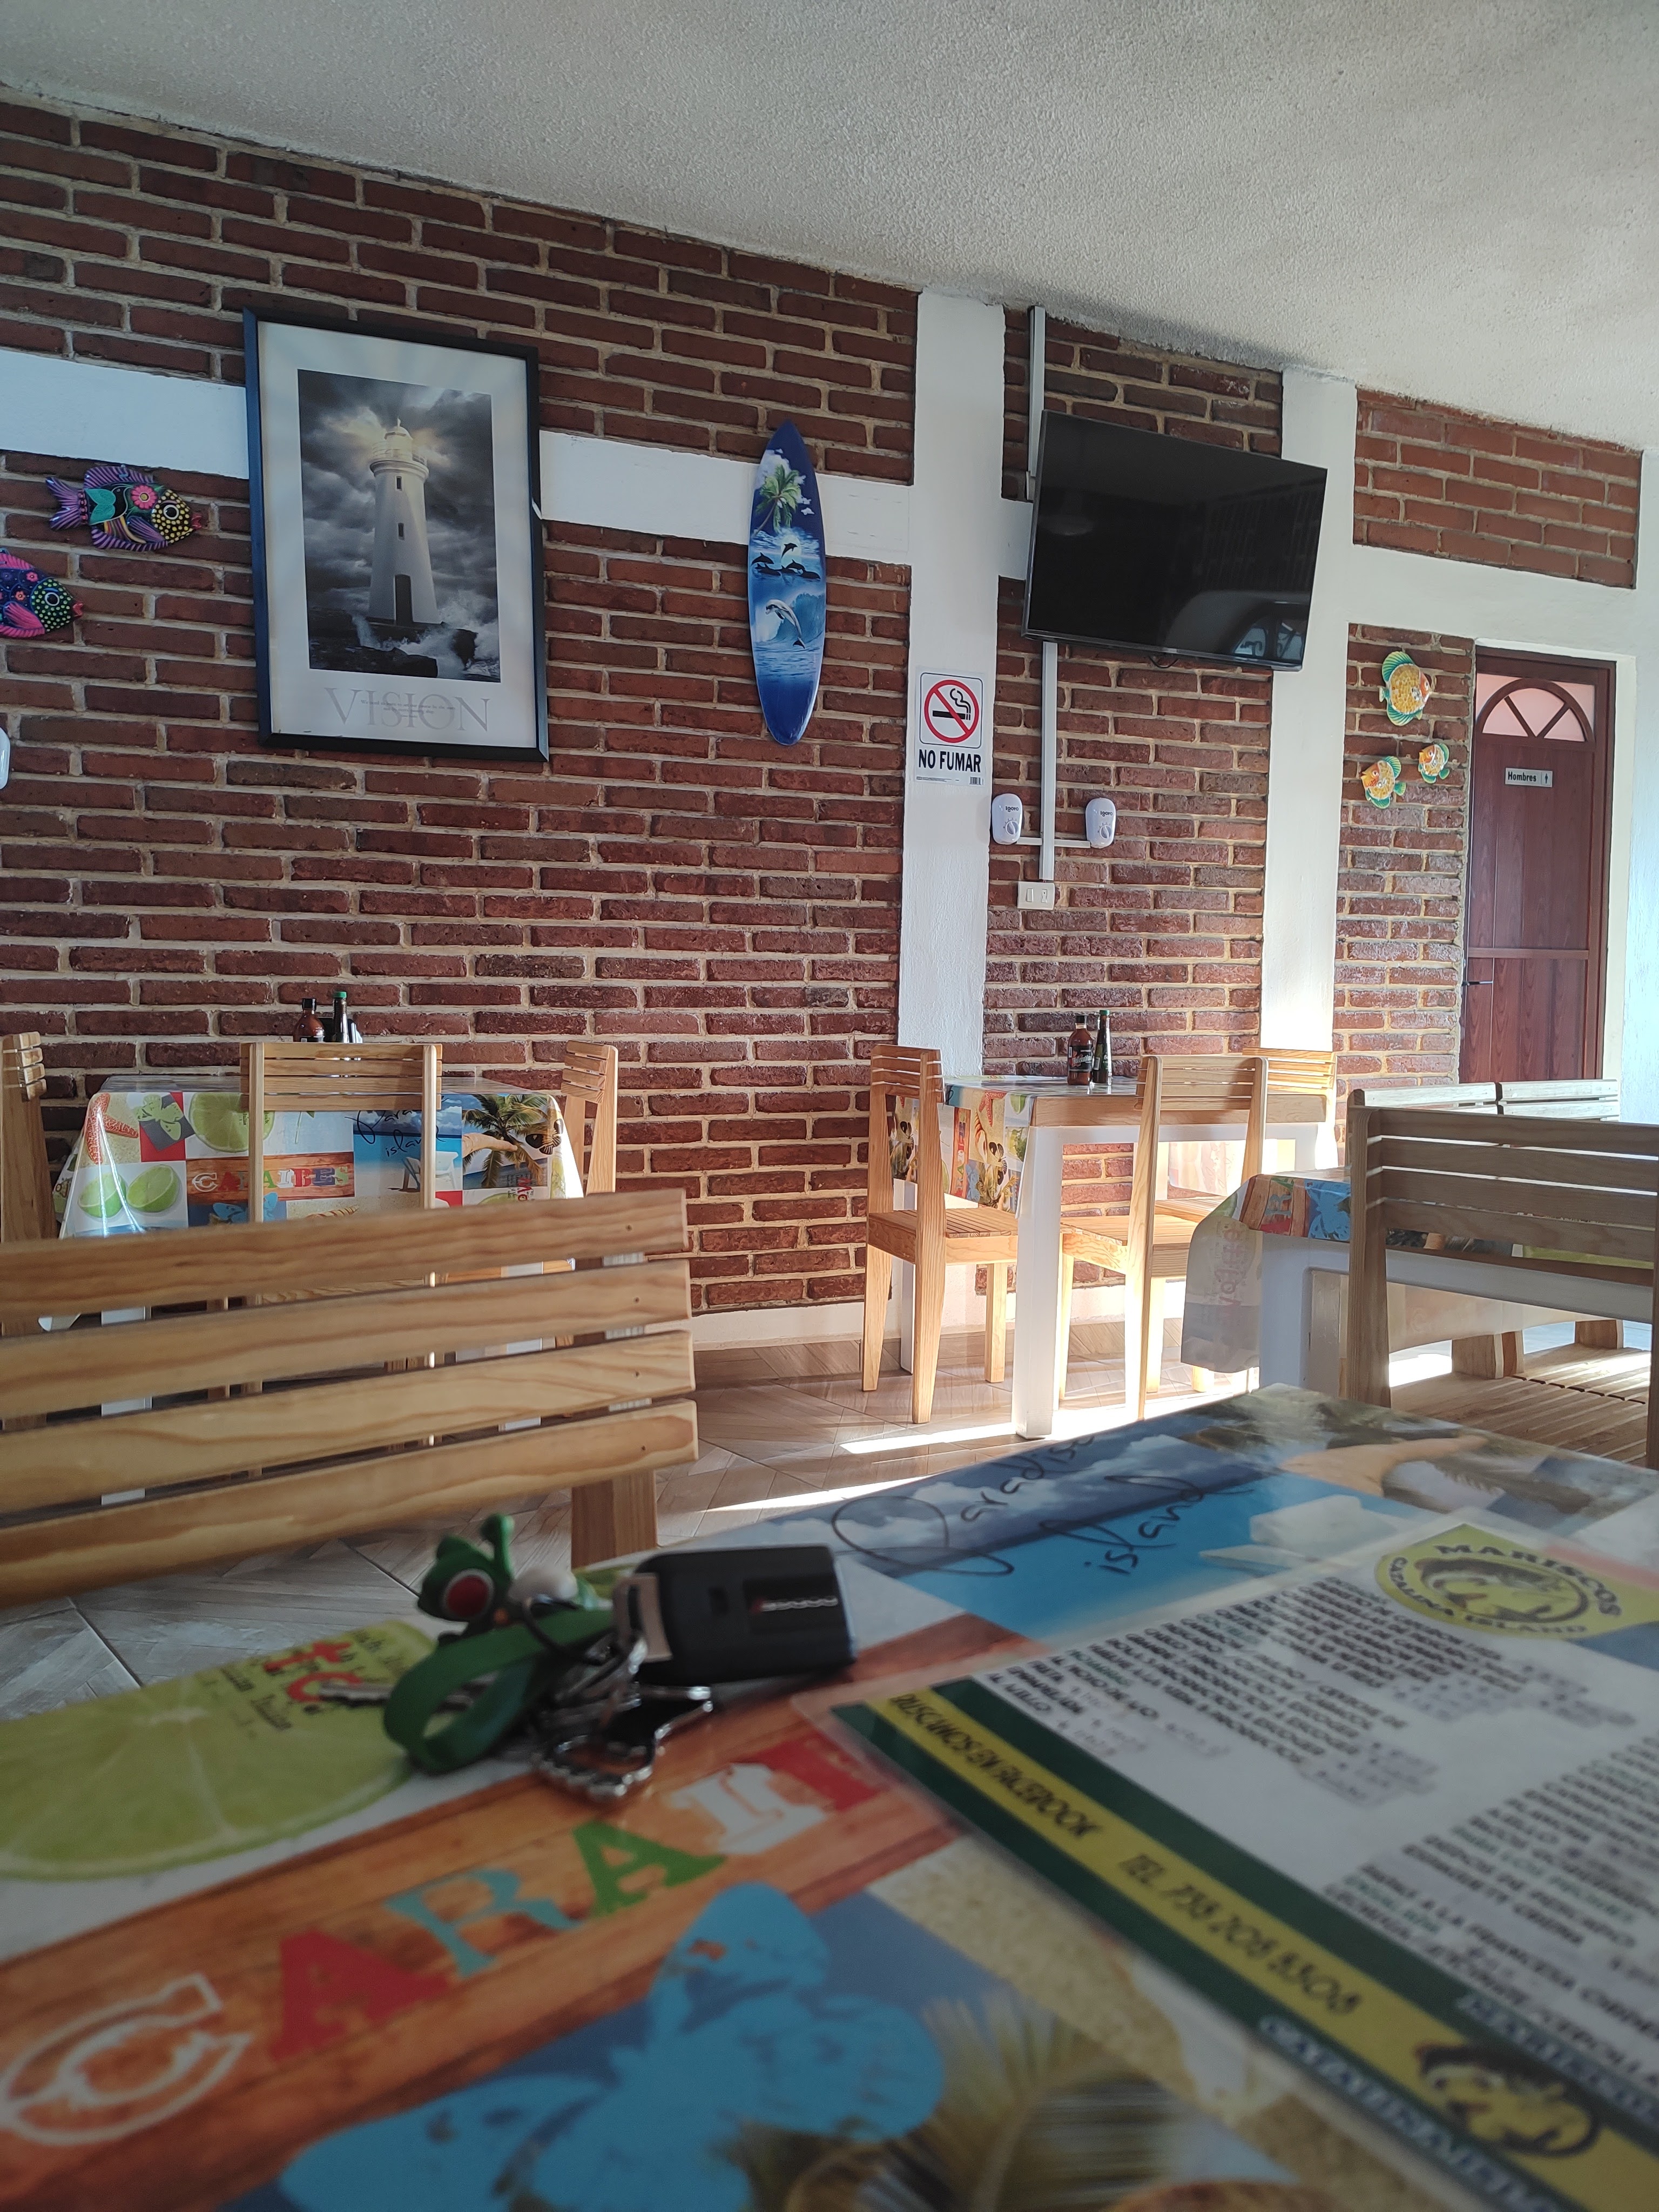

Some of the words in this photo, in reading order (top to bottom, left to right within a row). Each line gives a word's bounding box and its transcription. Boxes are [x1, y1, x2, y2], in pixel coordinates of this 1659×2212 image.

[325, 687, 490, 732] VISION
[919, 749, 936, 769] NO
[940, 751, 981, 773] FUMAR
[1508, 771, 1536, 781] Hombres
[1040, 1474, 1254, 1575] island
[1434, 1543, 1622, 1616] MARISCOS
